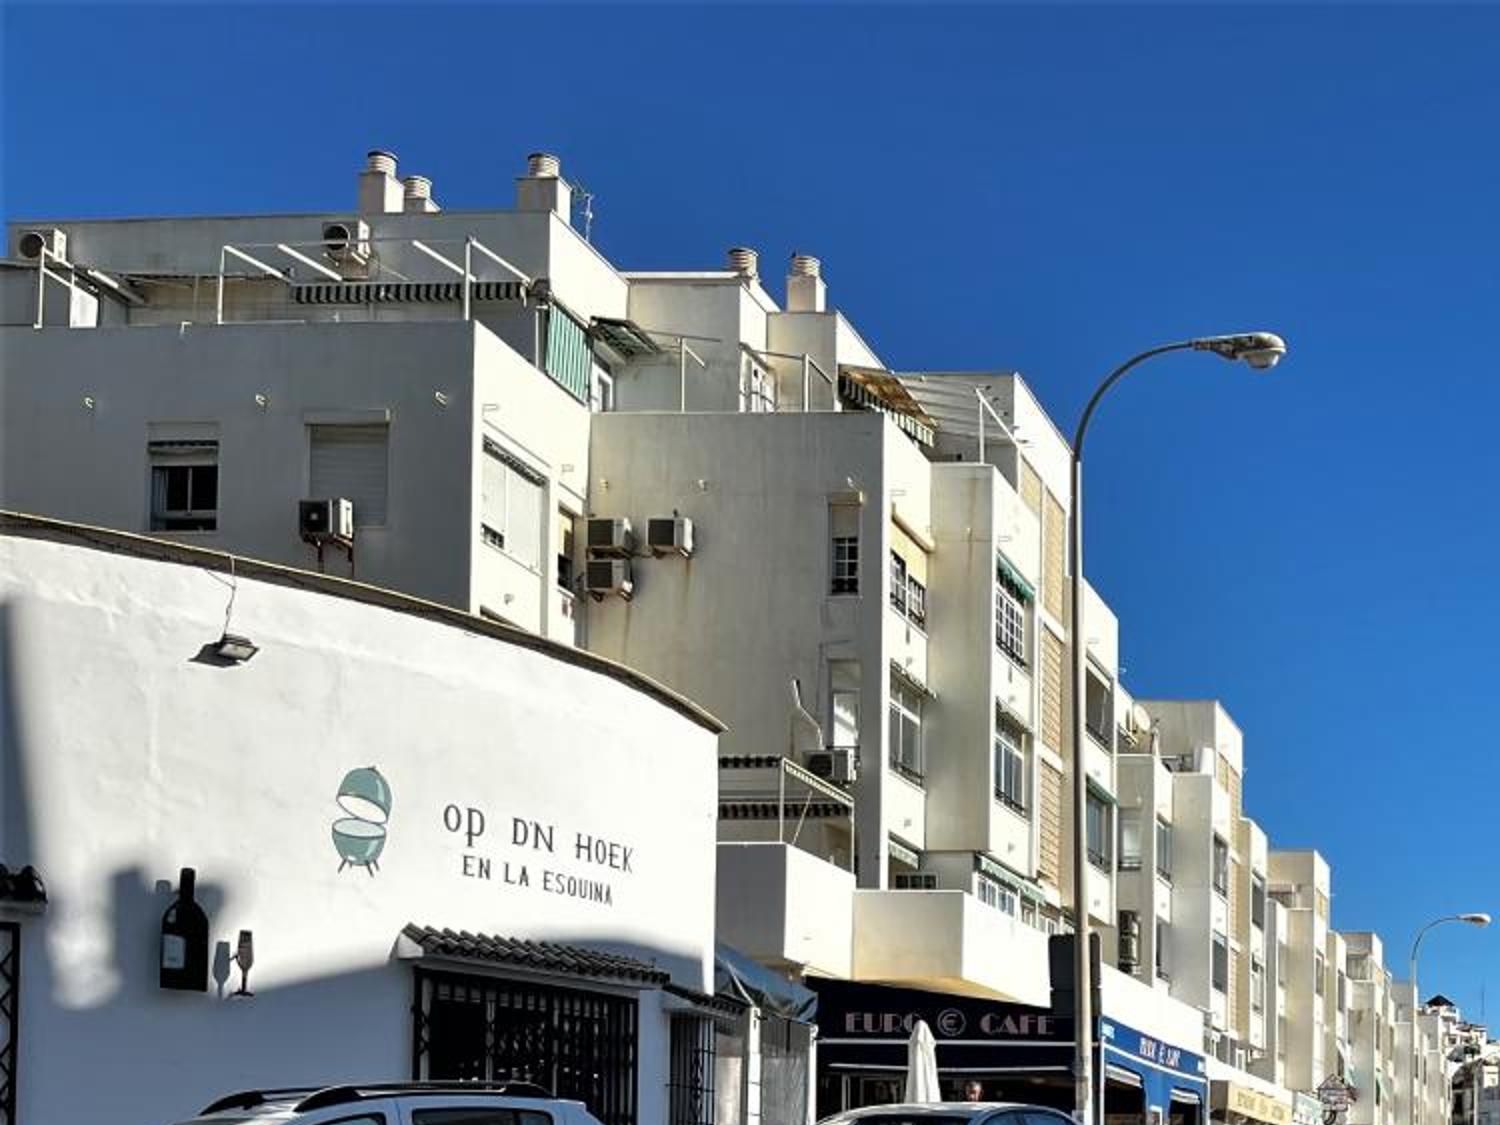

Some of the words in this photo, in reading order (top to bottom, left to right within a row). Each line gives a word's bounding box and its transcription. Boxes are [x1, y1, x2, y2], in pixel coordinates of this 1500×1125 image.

[575, 832, 634, 874] HOEK
[463, 855, 491, 881] EN
[504, 862, 529, 887] LA
[543, 870, 613, 907] ESQUINA
[979, 1014, 1054, 1036] CAFE
